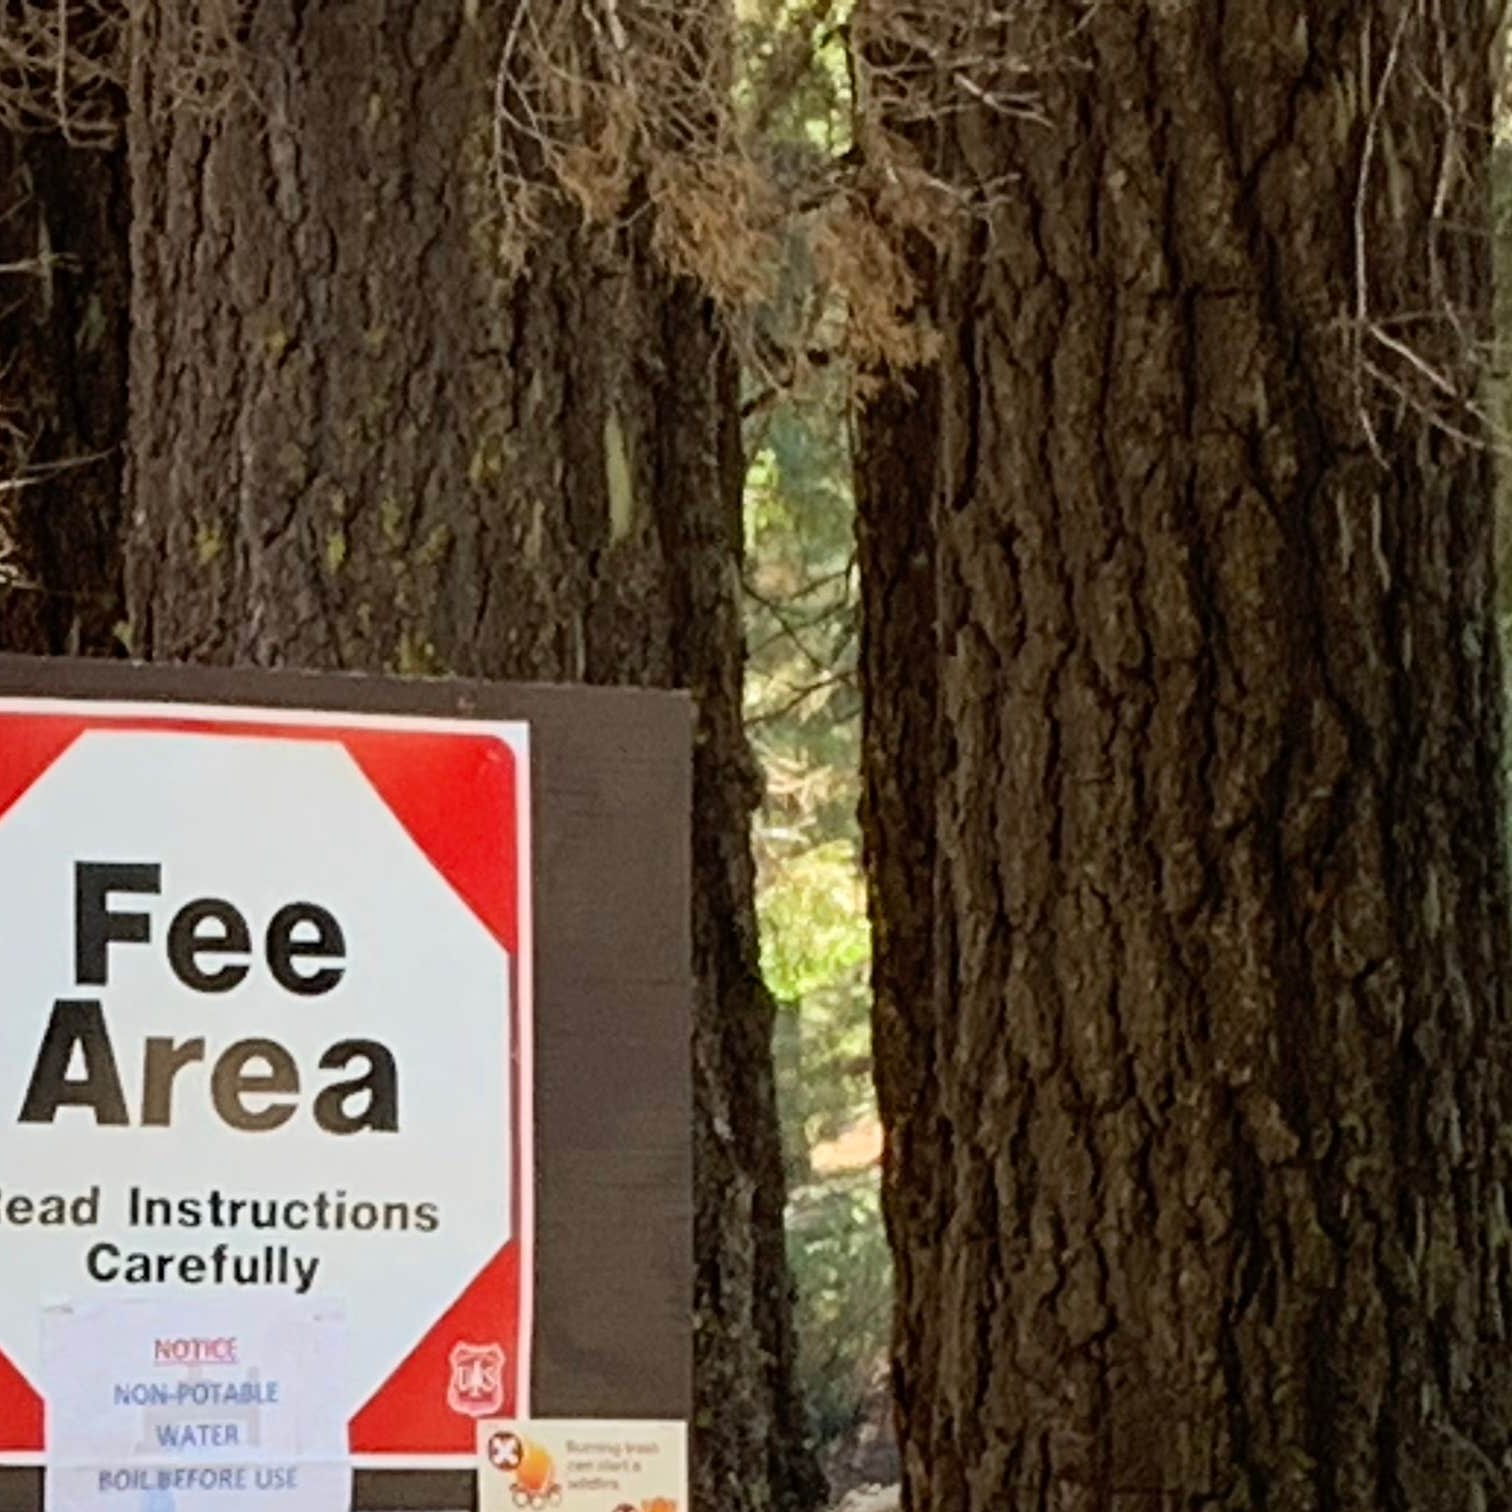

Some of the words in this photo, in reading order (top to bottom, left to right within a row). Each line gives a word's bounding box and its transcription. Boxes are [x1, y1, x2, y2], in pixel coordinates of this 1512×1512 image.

[73, 860, 347, 997] Fee
[17, 998, 399, 1135] Area
[129, 1186, 440, 1233] Instructions
[87, 1242, 320, 1292] Carefully
[155, 1338, 237, 1361] NOTICE
[114, 1382, 279, 1406] NON-POTABLE
[155, 1425, 239, 1447] WATER
[99, 1470, 151, 1491] BOIL
[157, 1468, 248, 1490] BEFORE
[255, 1467, 298, 1490] USE
